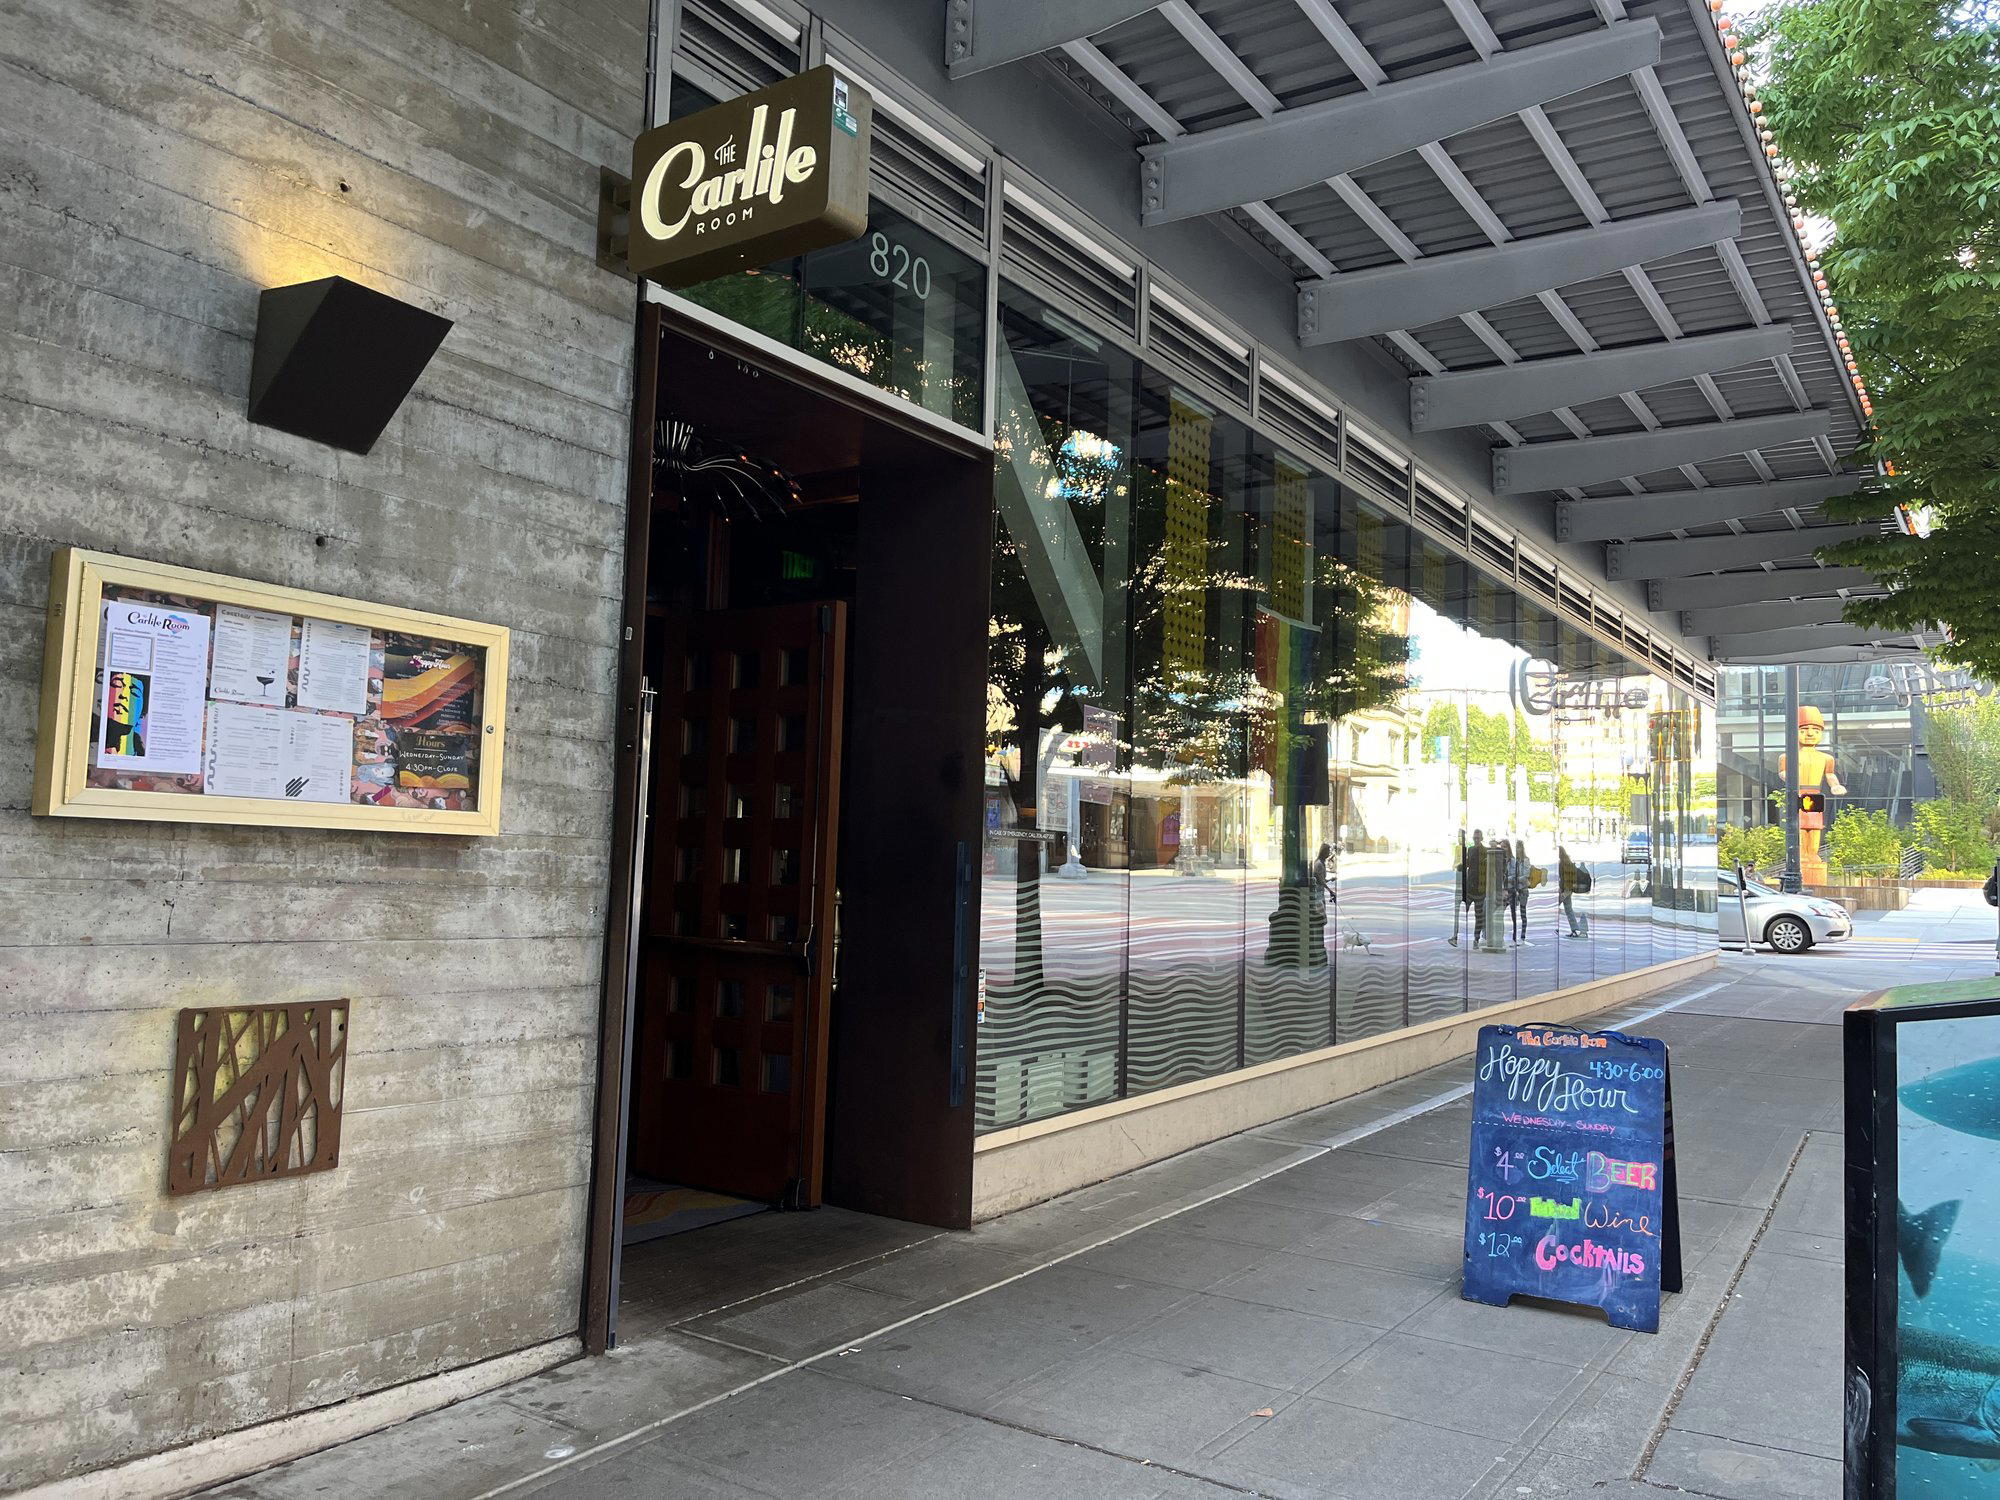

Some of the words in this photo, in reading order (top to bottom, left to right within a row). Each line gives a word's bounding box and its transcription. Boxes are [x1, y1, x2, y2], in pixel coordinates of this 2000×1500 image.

[714, 134, 737, 166] THE
[641, 104, 817, 240] Carlile
[696, 207, 753, 235] ROOM
[870, 232, 931, 300] 820
[127, 611, 162, 627] Carlile
[162, 618, 190, 631] Room
[416, 736, 446, 748] Hours
[1517, 1031, 1541, 1046] The
[1581, 1034, 1607, 1048] Room
[1480, 1045, 1567, 1112] Happy
[1589, 1061, 1664, 1081] 4:30-6:00
[1553, 1077, 1639, 1113] Hour
[1575, 1120, 1616, 1134] SUNDAY
[1527, 1146, 1585, 1181] Select
[1587, 1151, 1657, 1193] BEER
[1585, 1201, 1655, 1236] Wine
